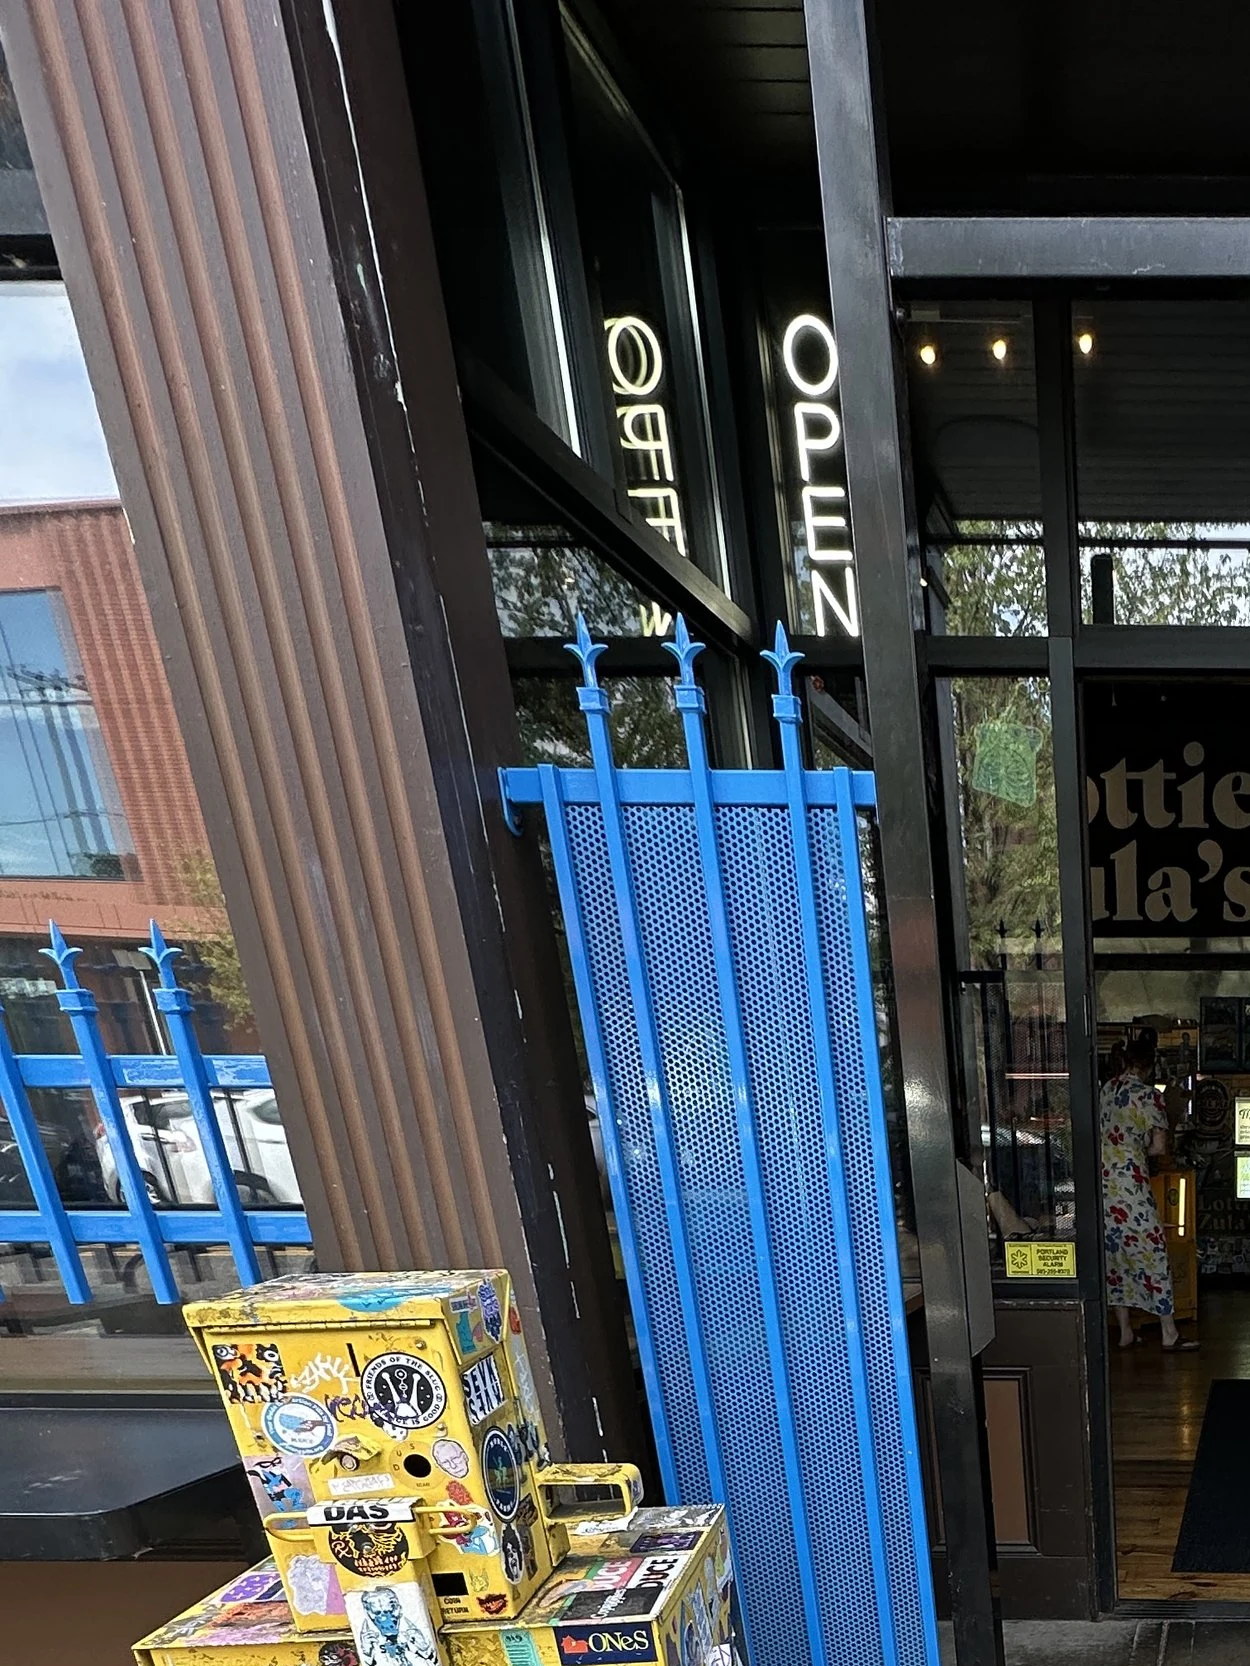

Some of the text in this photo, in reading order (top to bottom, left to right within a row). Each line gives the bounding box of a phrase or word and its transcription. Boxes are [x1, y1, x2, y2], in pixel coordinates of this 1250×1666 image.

[783, 314, 860, 638] OPEN
[366, 1359, 387, 1389] FRIENDS
[405, 1358, 423, 1370] THE
